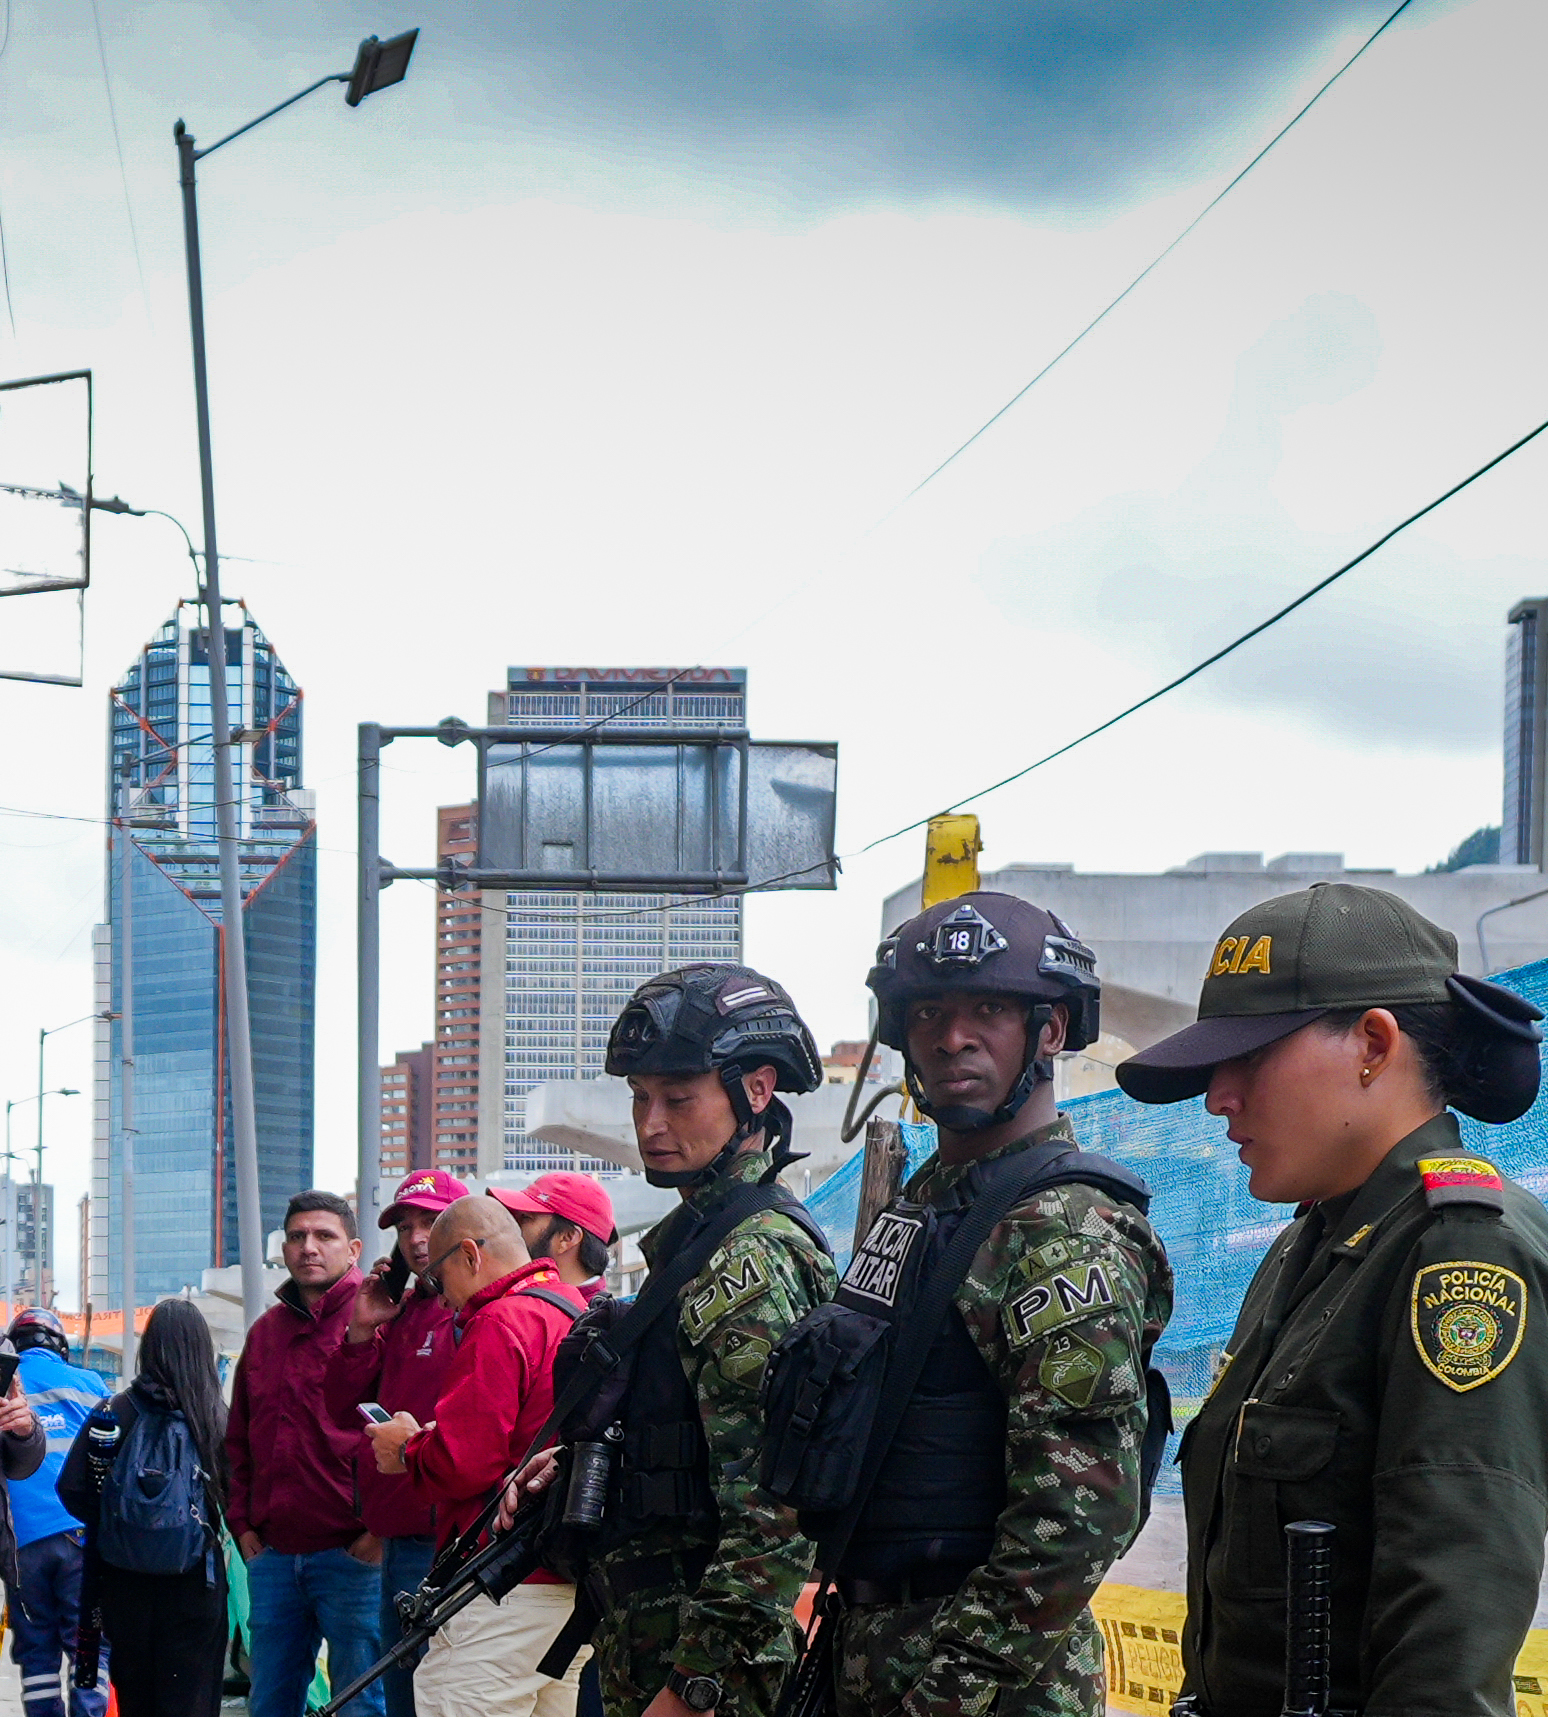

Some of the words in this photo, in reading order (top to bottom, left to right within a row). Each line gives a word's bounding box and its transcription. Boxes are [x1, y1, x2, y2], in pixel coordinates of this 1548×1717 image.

[949, 931, 970, 950] 18
[689, 1254, 765, 1329] PM
[1439, 1271, 1506, 1294] POLICÍA
[1011, 1263, 1113, 1341] PM
[1423, 1286, 1515, 1317] NACIONAL
[1055, 1336, 1070, 1354] 13
[1438, 1363, 1490, 1377] COLOMBIA
[1128, 1641, 1183, 1684] PELIGR
